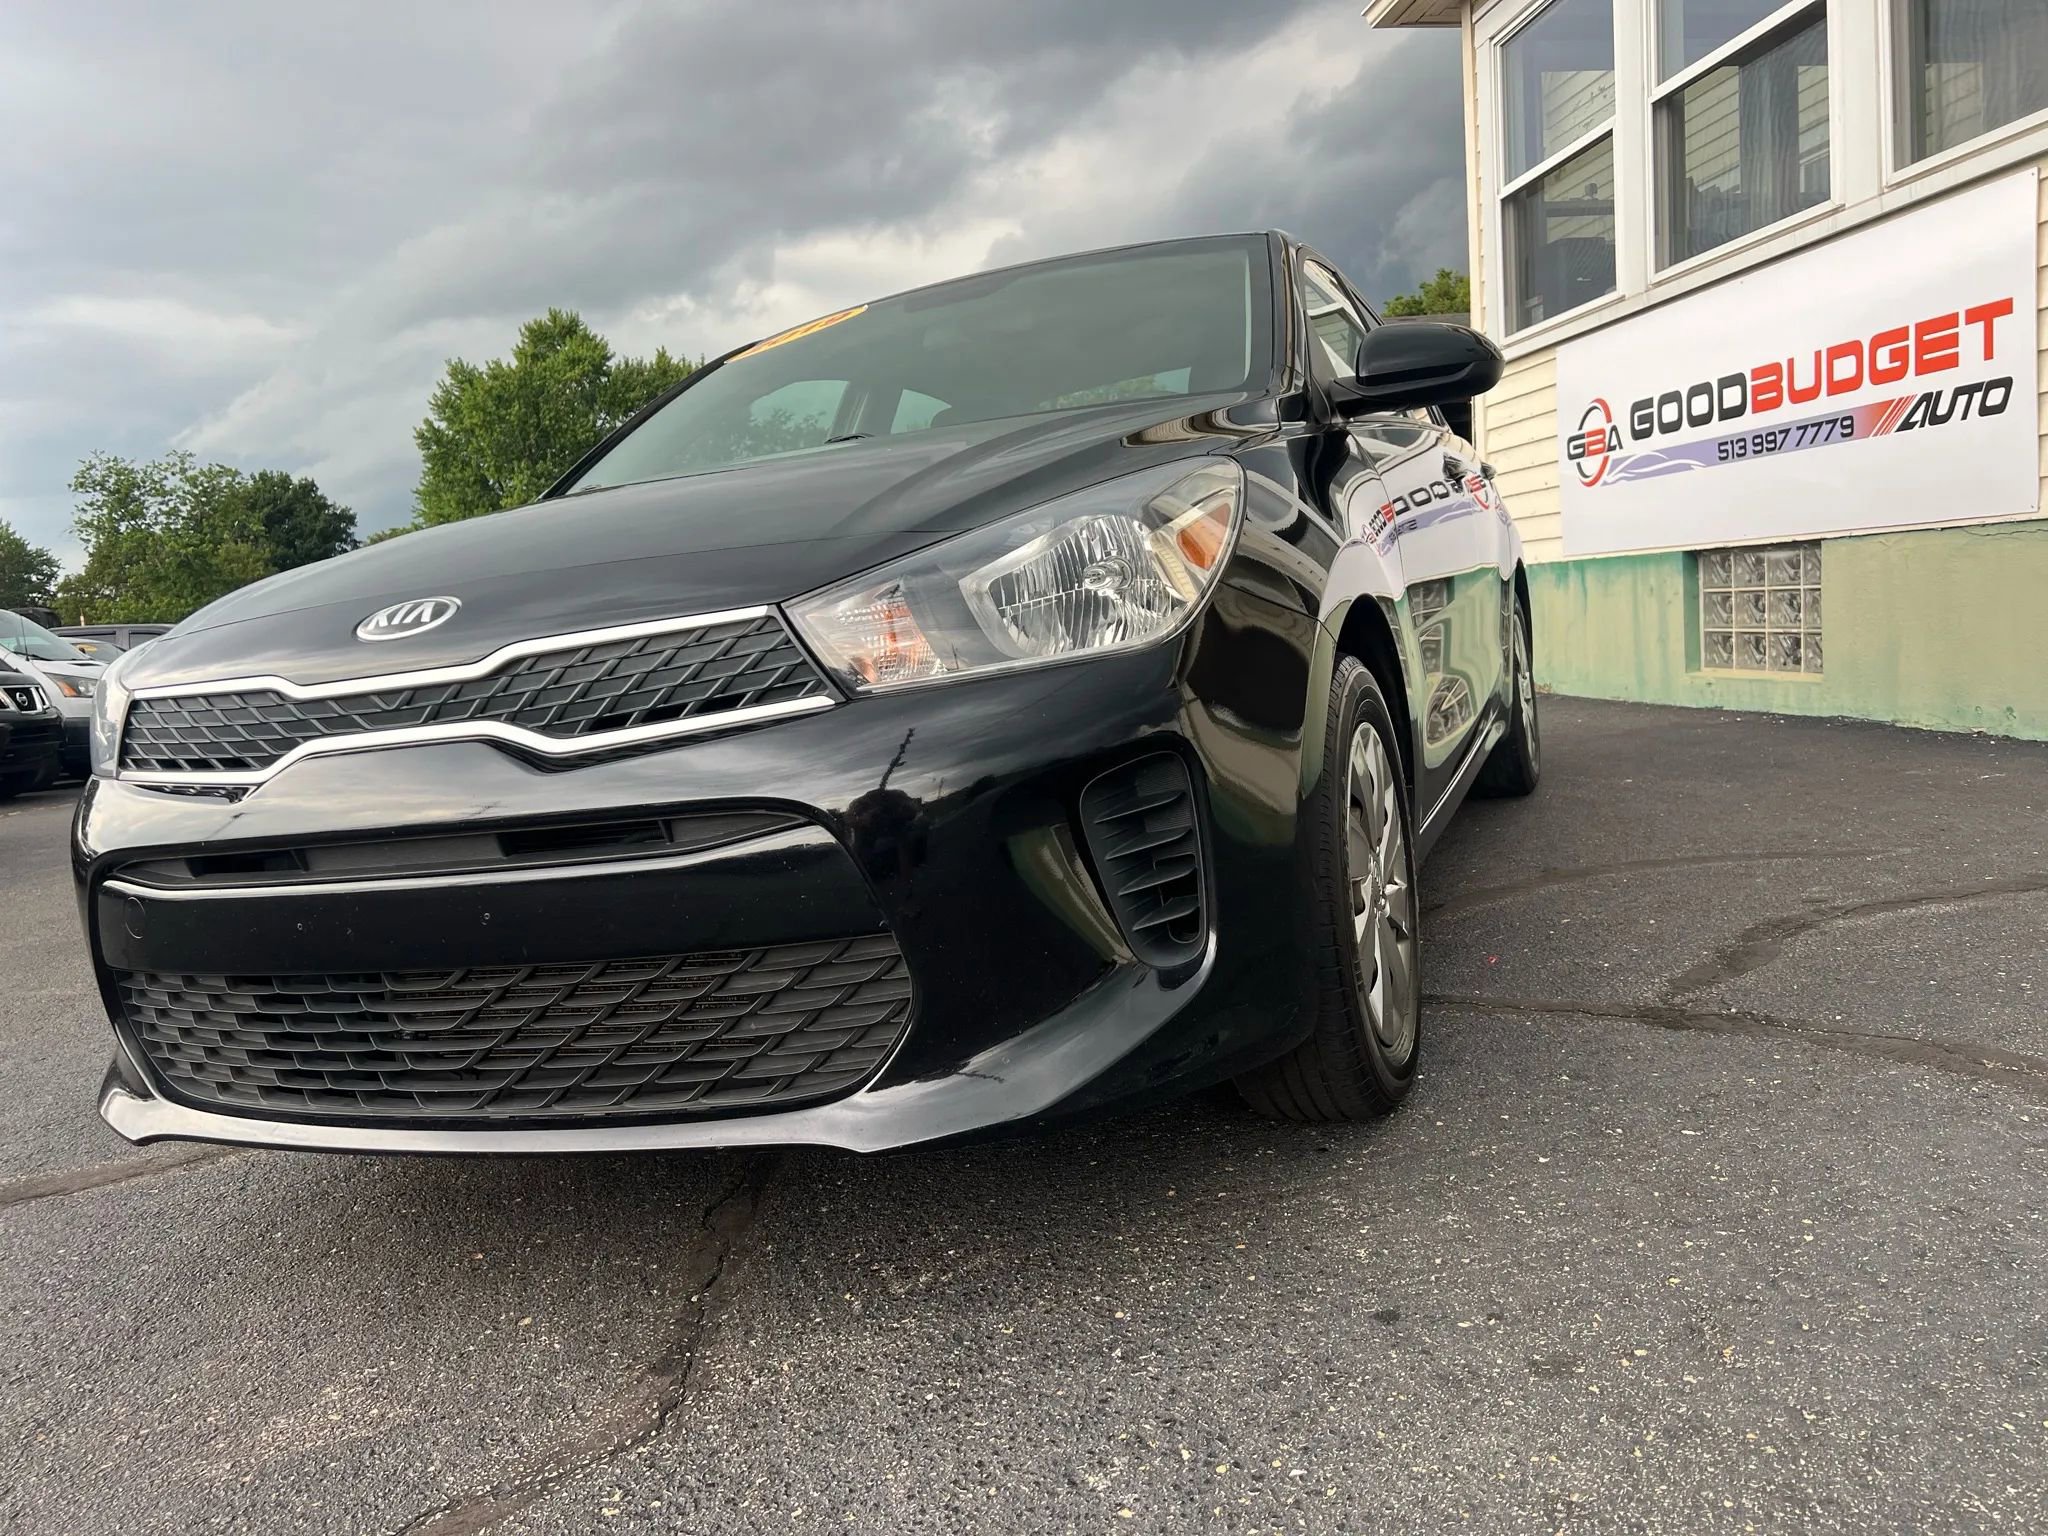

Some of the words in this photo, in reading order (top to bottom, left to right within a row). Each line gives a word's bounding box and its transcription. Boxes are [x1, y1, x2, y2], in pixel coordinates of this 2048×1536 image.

[1894, 376, 2014, 432] AUTO
[1567, 425, 1623, 461] GBA
[1717, 437, 1747, 461] 513
[1752, 428, 1791, 455] 997
[1795, 415, 1855, 448] 7779
[366, 601, 436, 631] KIA
